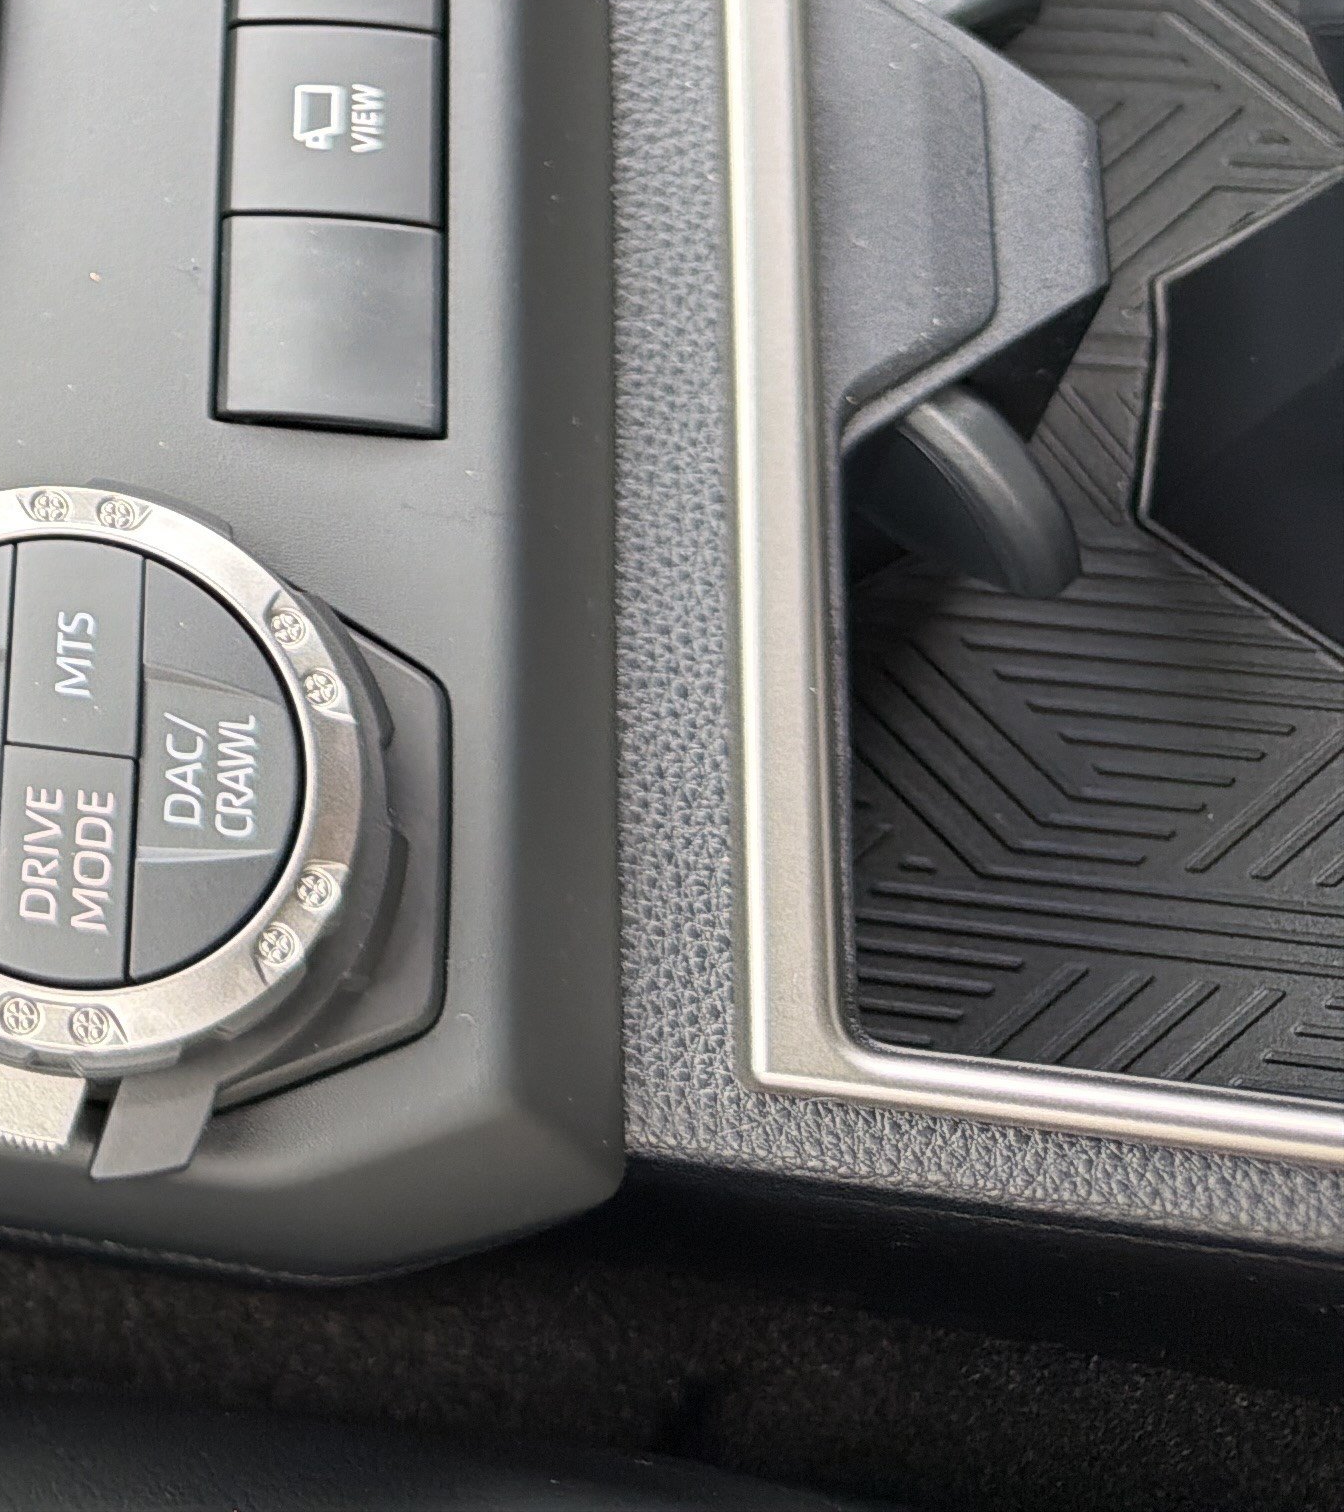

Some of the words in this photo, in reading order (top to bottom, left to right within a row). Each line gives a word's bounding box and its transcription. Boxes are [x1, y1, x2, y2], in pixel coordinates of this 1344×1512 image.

[351, 83, 385, 154] VIEW
[55, 611, 98, 699] MTS
[164, 712, 208, 827] DAC/
[215, 715, 256, 839] CRAWL
[19, 786, 64, 923] DRIVE
[71, 789, 115, 933] MODE
